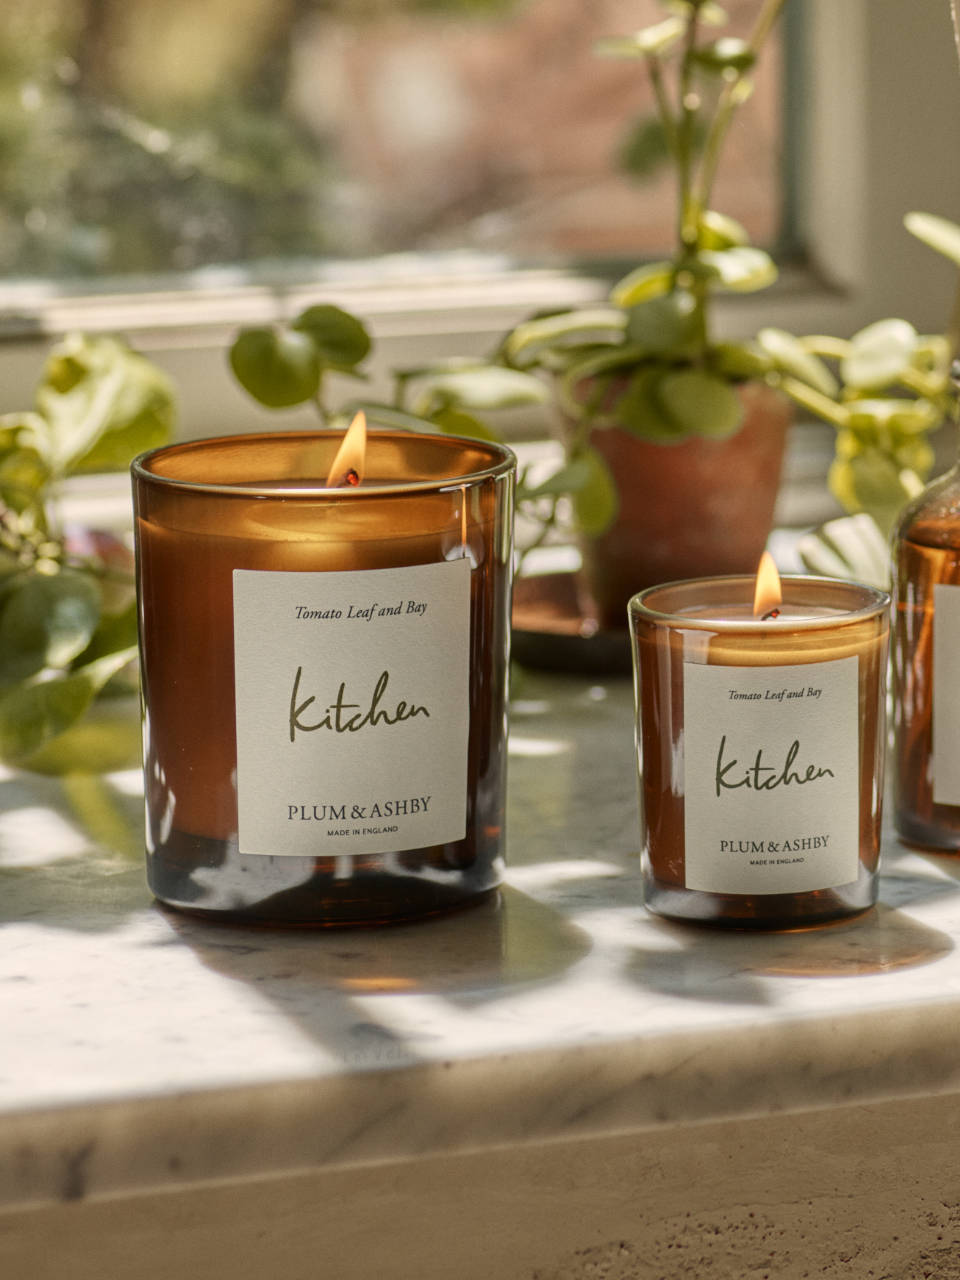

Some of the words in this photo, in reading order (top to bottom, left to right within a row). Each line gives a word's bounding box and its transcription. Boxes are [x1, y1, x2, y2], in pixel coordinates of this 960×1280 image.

[295, 606, 342, 619] Tomato
[347, 605, 378, 622] Leaf
[378, 600, 403, 616] and
[406, 600, 428, 616] Bay
[728, 689, 762, 701] Tomato
[764, 689, 787, 703] Leaf
[786, 687, 805, 699] and
[806, 687, 822, 699] Bay
[327, 829, 350, 837] MADE
[352, 828, 360, 836] IN
[362, 825, 399, 835] ENGLAND
